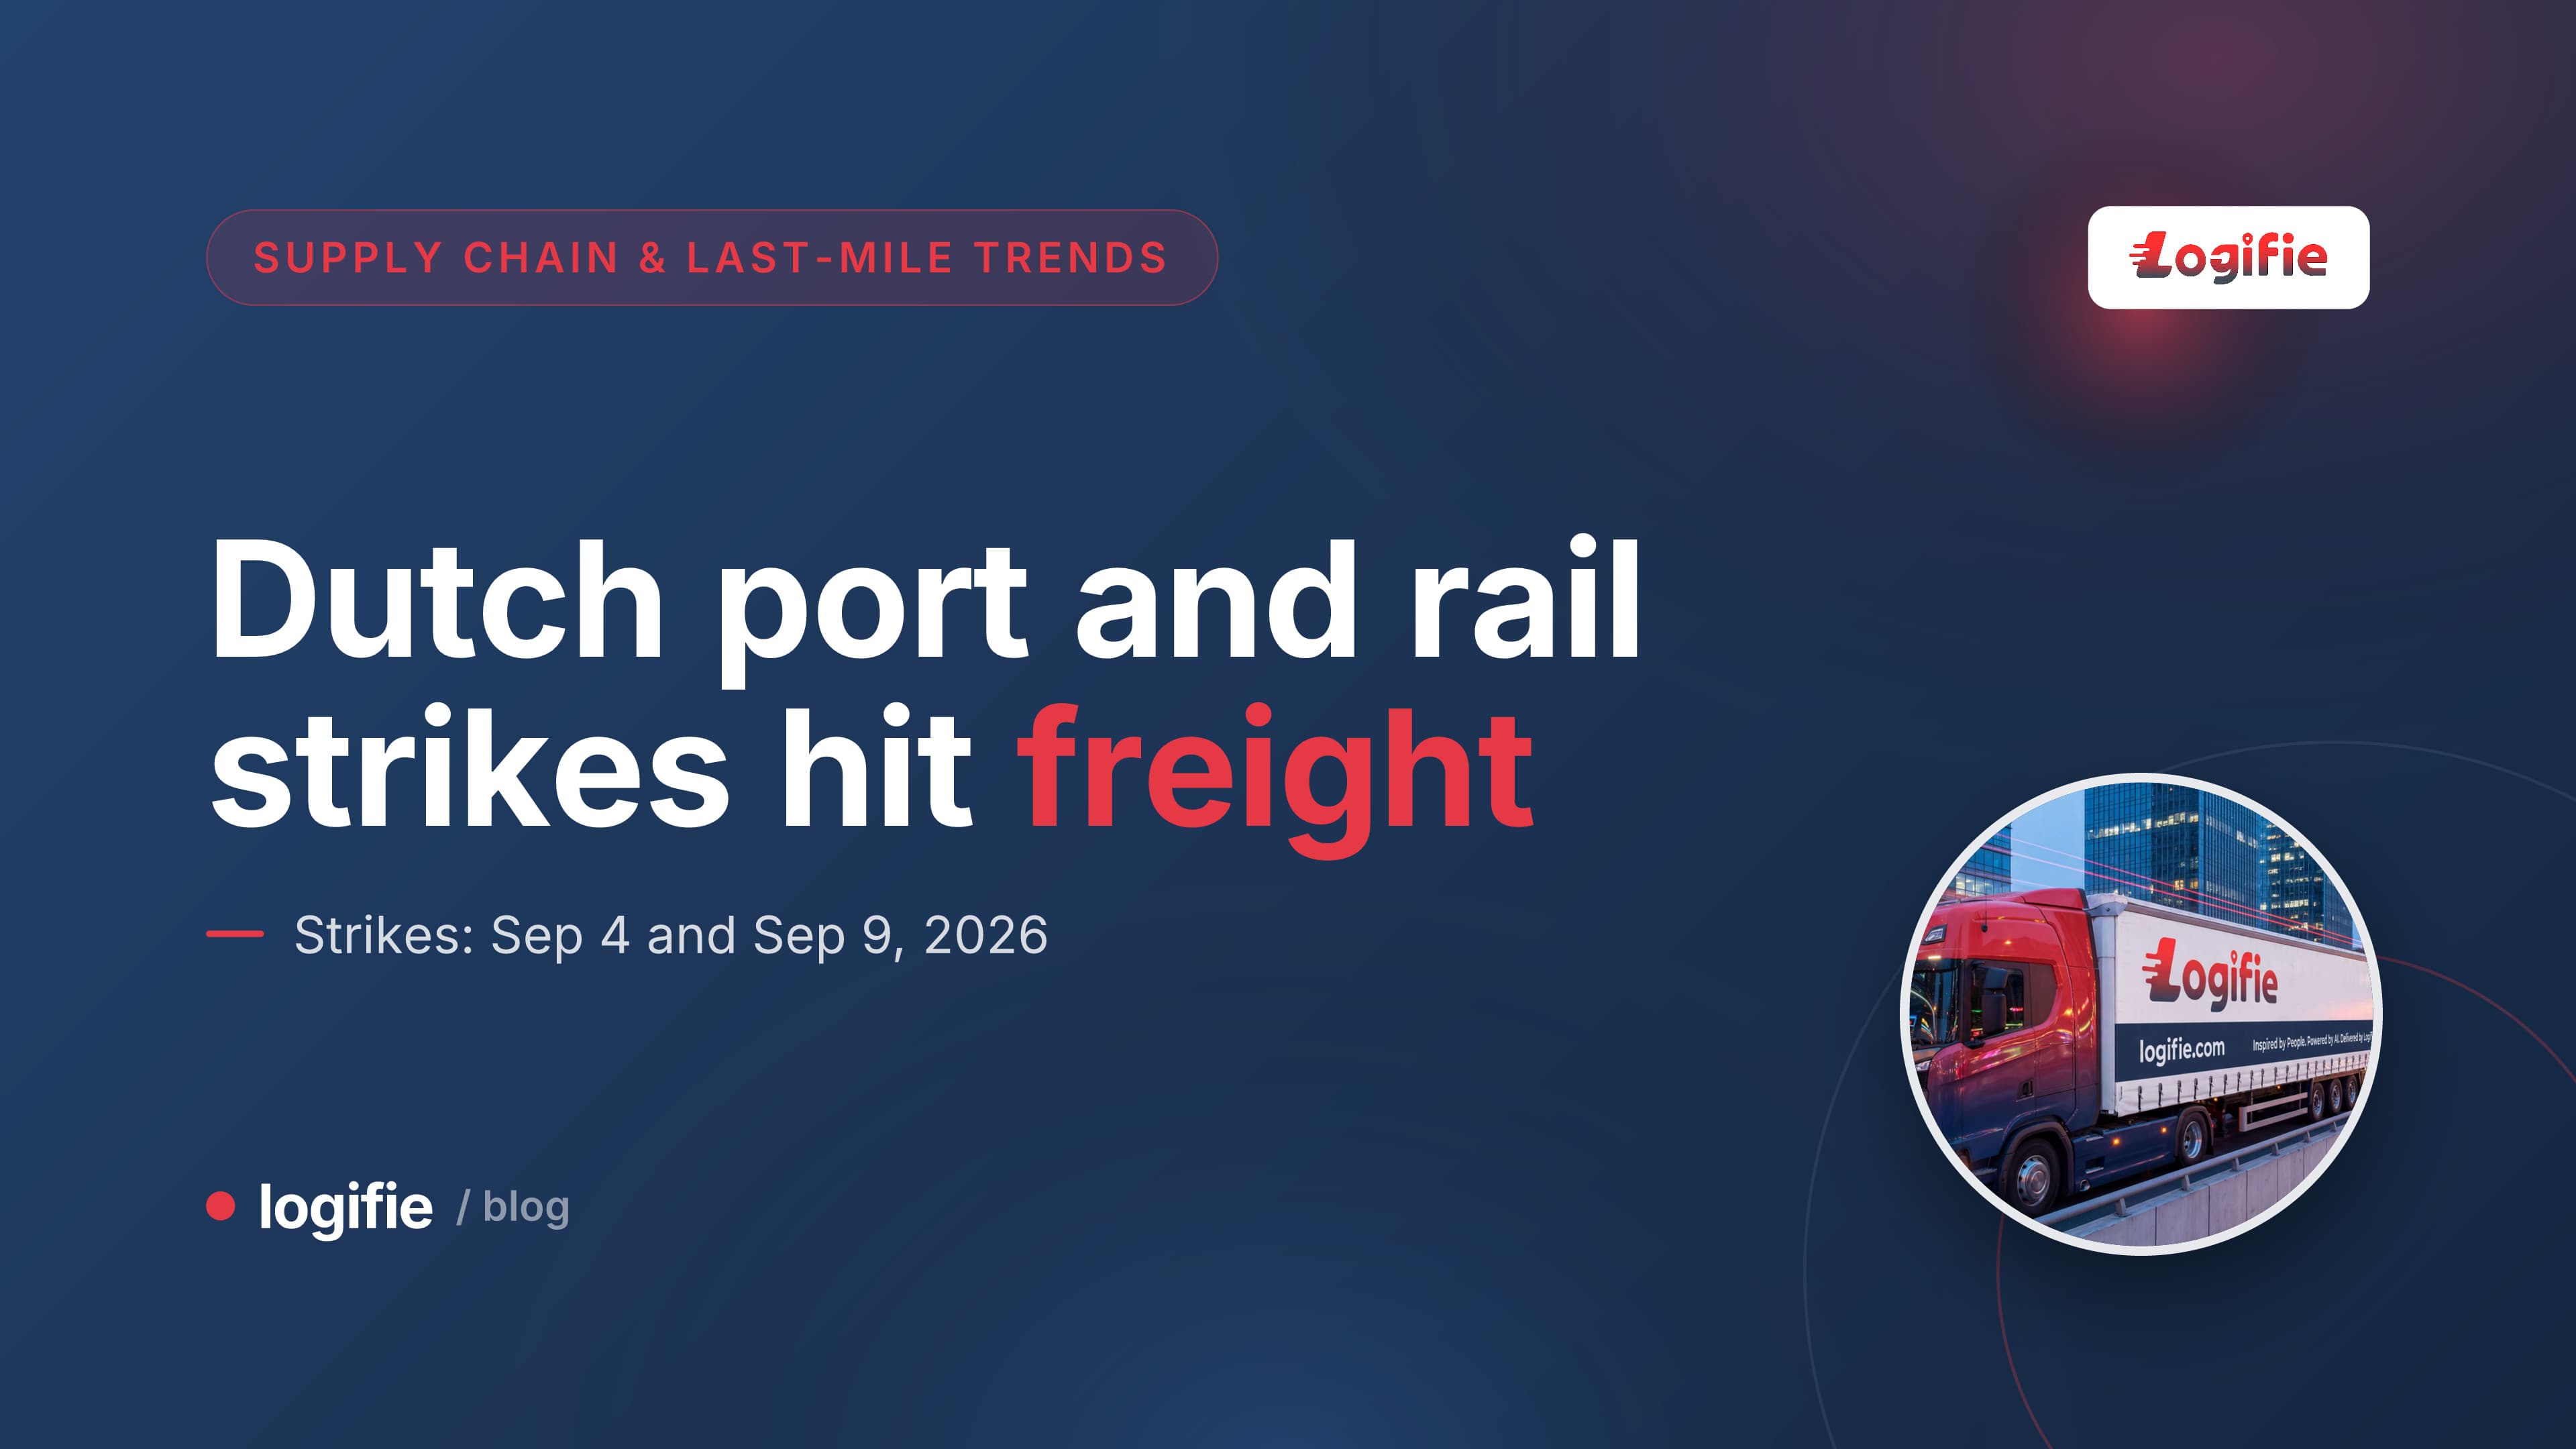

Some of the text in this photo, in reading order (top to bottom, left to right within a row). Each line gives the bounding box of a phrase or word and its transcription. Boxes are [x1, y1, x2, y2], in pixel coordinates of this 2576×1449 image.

[2142, 937, 2277, 1012] Logifie
[2140, 1036, 2225, 1067] logifie.com
[2253, 1036, 2278, 1053] Inspired
[2279, 1036, 2286, 1051] by
[2287, 1035, 2306, 1050] People.
[2307, 1035, 2328, 1046] Powered
[2328, 1034, 2334, 1046] by
